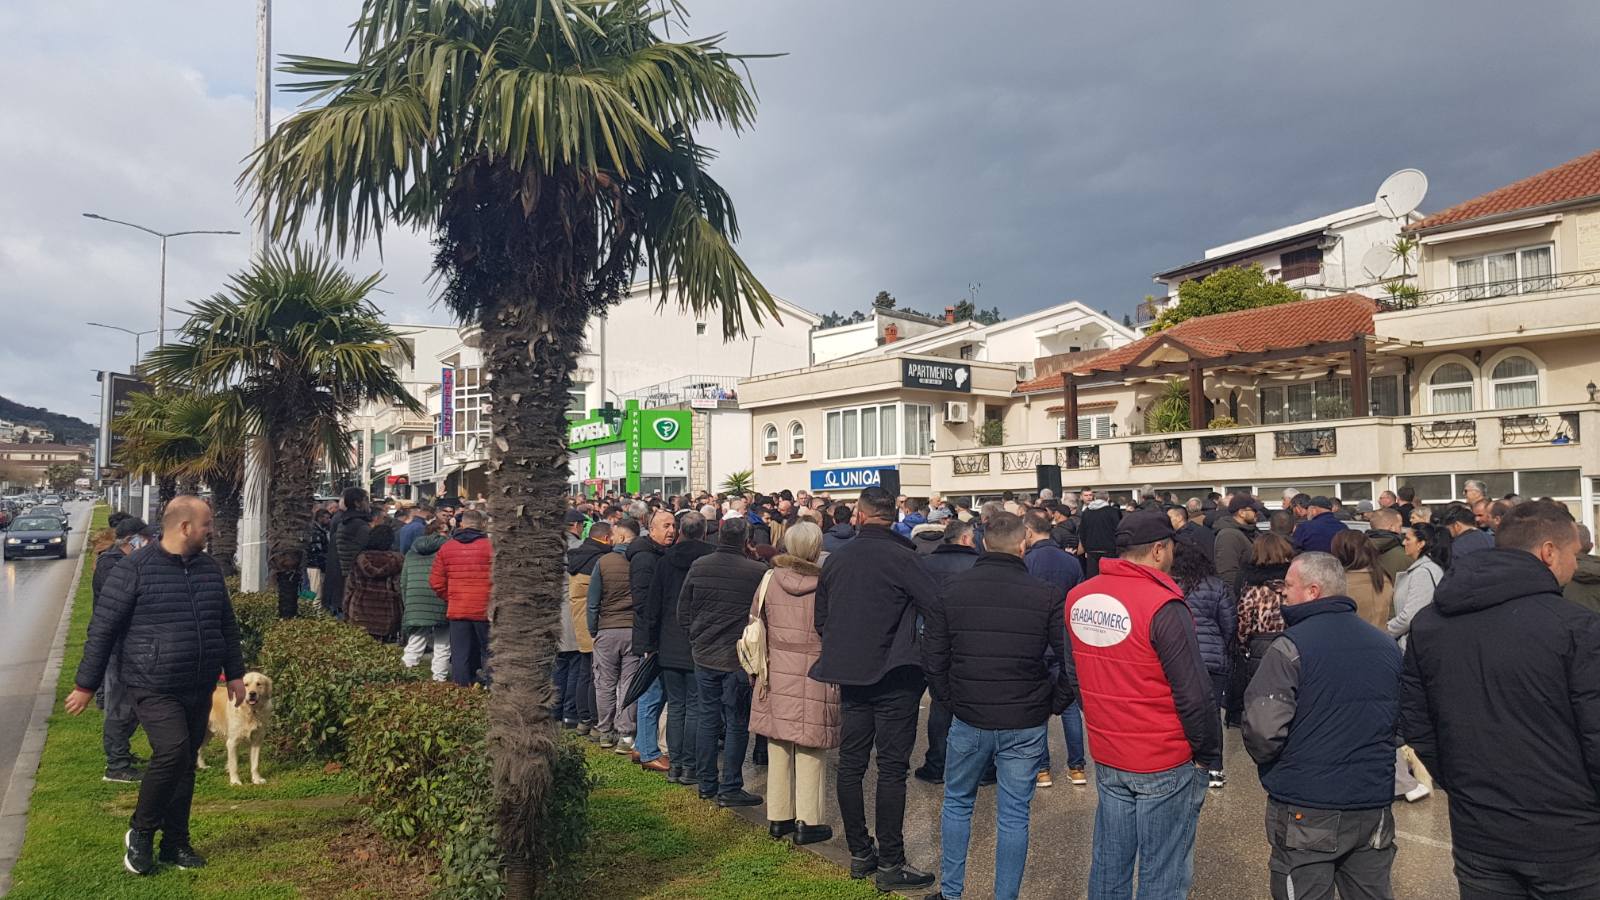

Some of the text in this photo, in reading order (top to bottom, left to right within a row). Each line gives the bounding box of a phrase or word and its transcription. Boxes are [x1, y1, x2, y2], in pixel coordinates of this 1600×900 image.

[908, 364, 952, 380] APARTMENTS
[841, 469, 880, 486] UNIQA
[1072, 608, 1128, 630] GRAĐACOMERC
